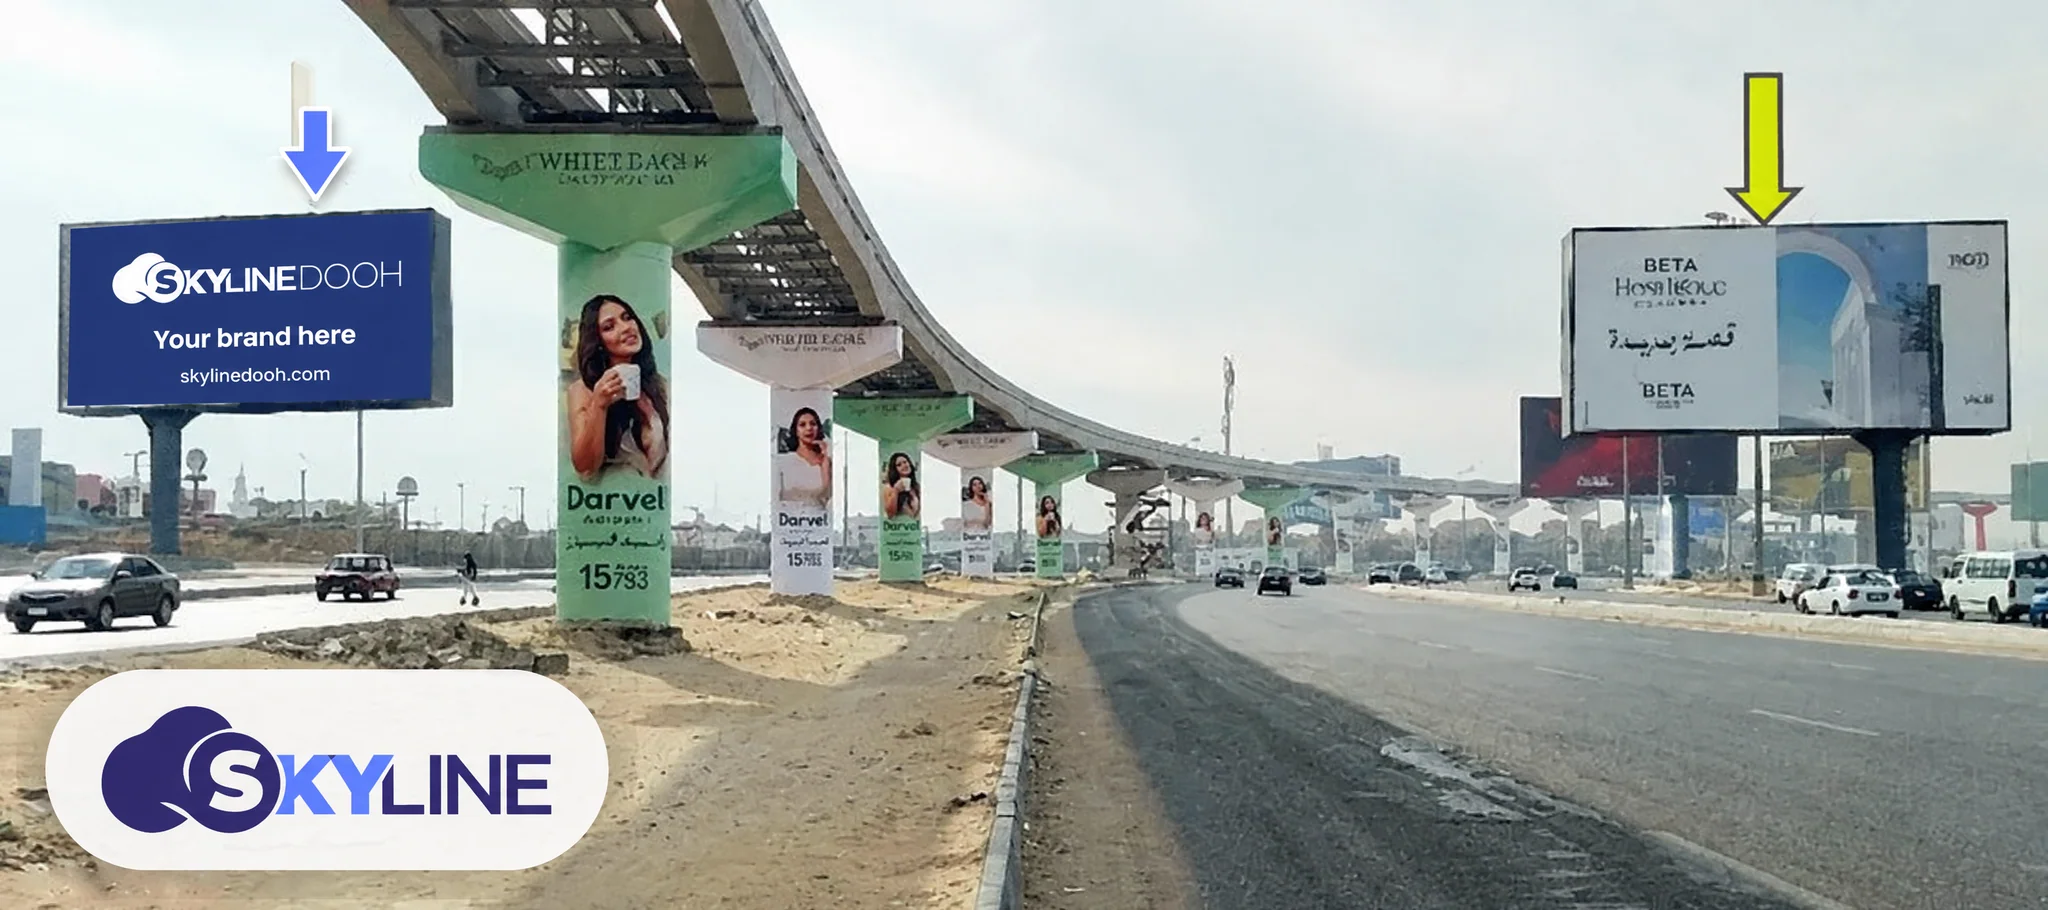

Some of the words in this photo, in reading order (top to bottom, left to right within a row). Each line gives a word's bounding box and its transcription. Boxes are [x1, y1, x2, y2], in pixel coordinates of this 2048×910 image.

[1644, 258, 1698, 273] BETA
[153, 329, 211, 350] Your
[216, 326, 290, 348] brand
[297, 325, 356, 345] here
[180, 366, 331, 388] skylinedooh.com
[1643, 383, 1695, 398] BETA
[567, 485, 665, 511] Darvel
[779, 512, 829, 527] Darvel
